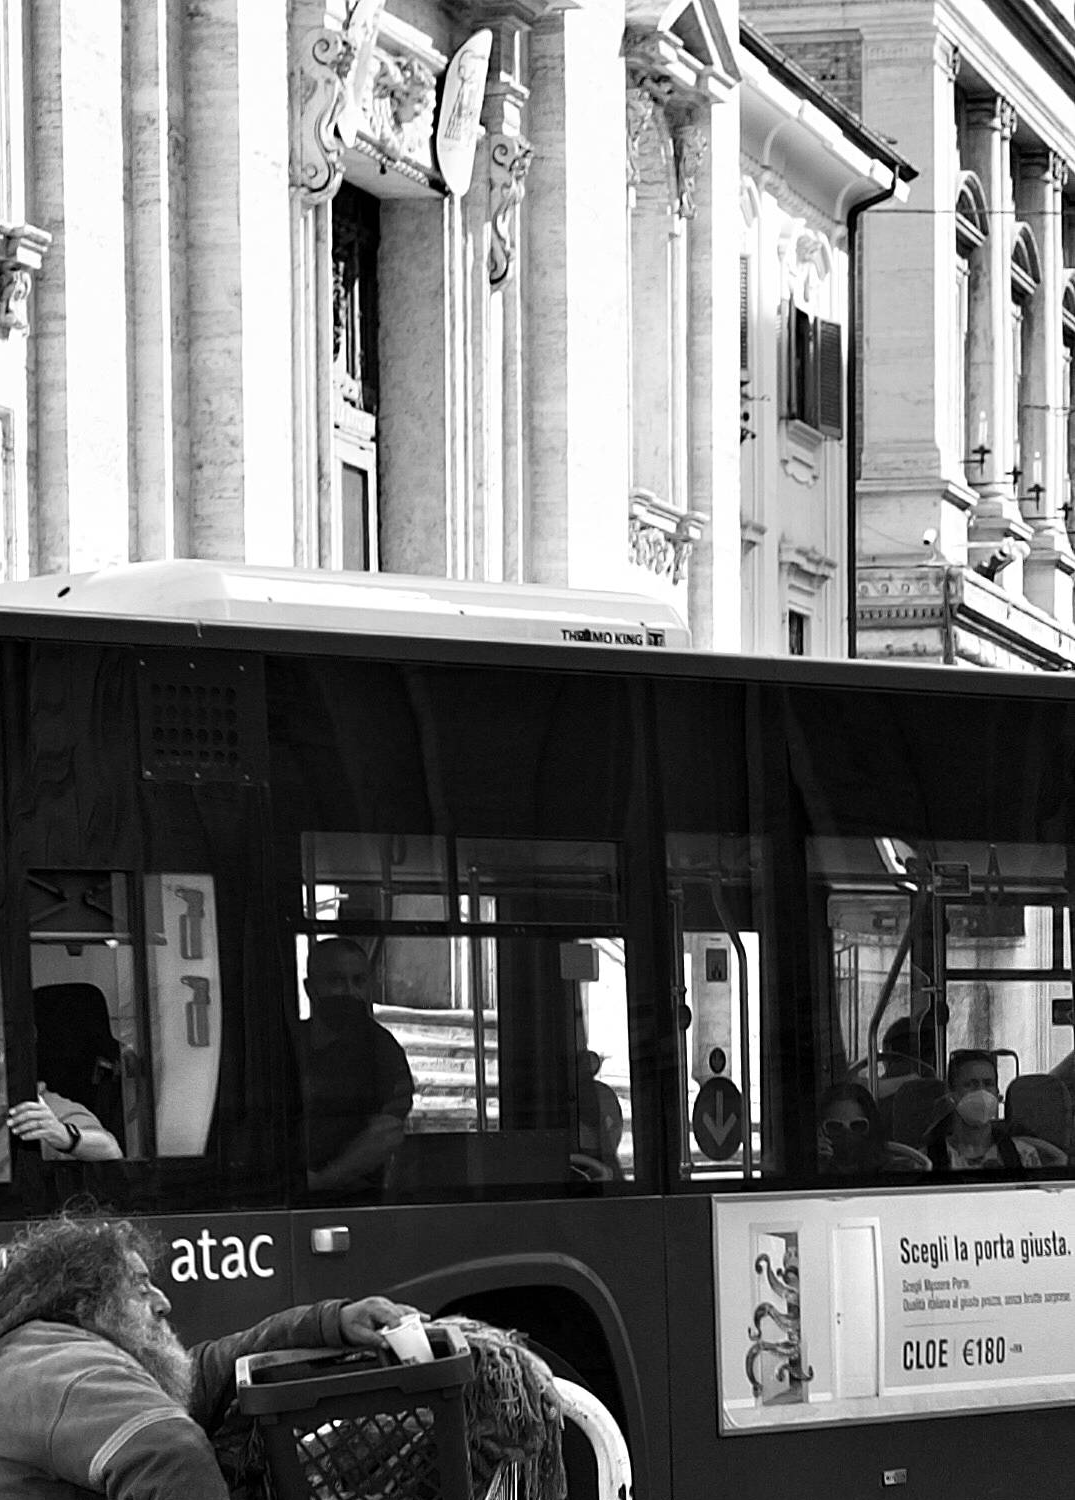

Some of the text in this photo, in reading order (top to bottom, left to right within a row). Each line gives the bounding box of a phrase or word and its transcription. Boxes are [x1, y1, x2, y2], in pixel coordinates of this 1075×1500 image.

[614, 631, 644, 647] KING
[171, 1229, 275, 1282] atac
[900, 1229, 1072, 1270] Scegli la porta giusta.
[902, 1338, 949, 1371] CLOE
[962, 1336, 1006, 1367] €180
